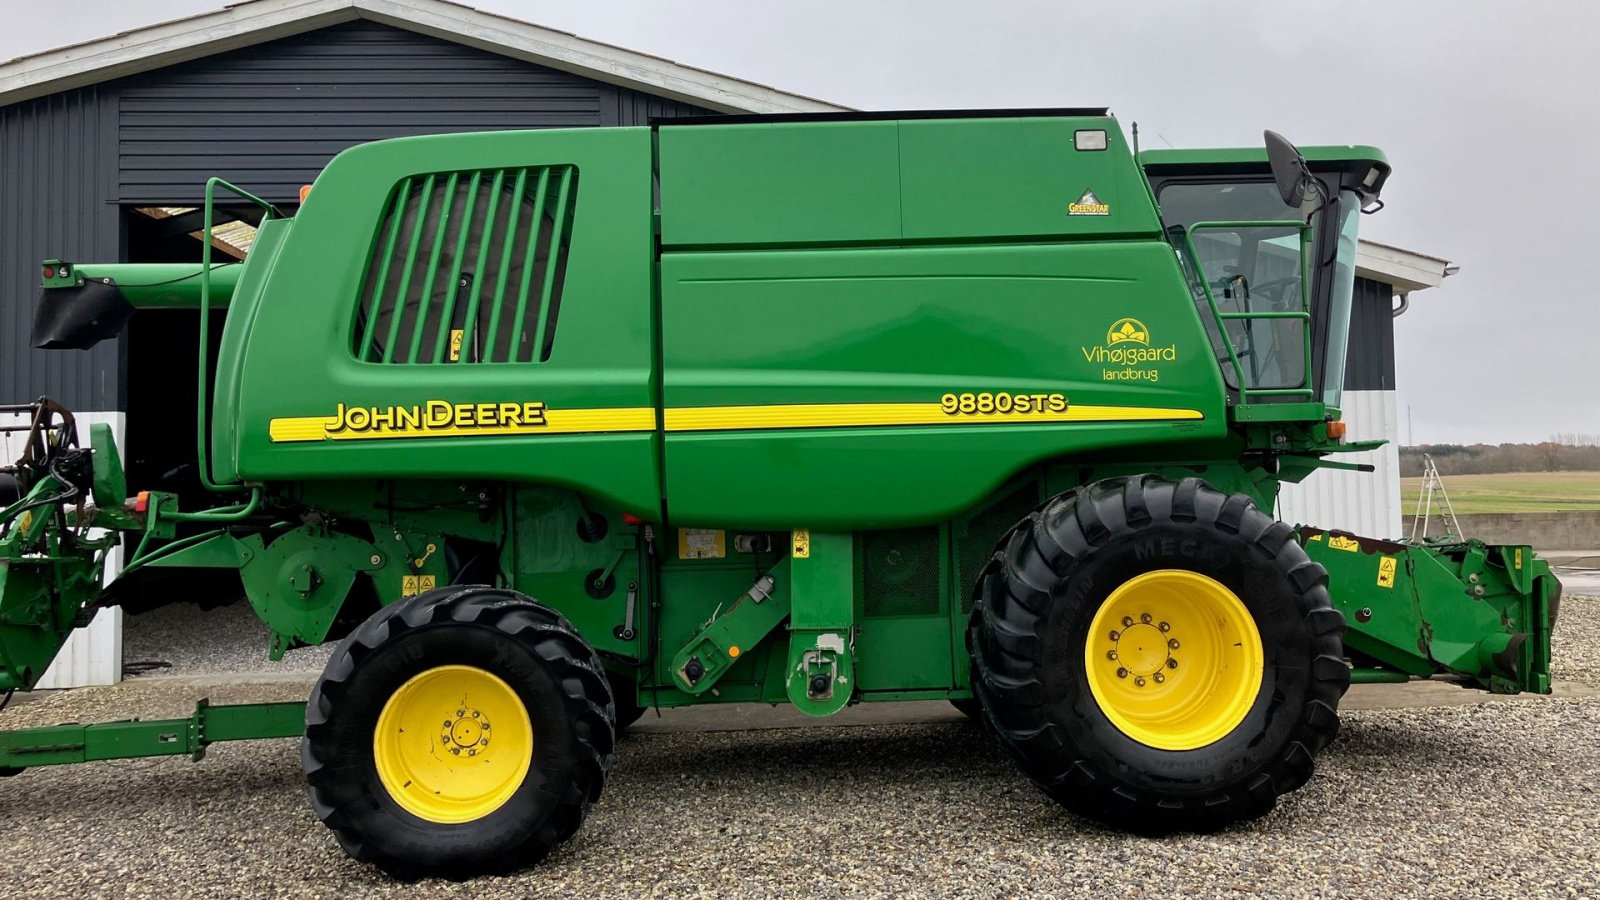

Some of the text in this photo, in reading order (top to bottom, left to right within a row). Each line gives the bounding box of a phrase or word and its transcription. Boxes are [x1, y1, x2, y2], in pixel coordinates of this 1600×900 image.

[1082, 344, 1176, 366] Vihøjgaard
[1102, 368, 1159, 382] landbrug
[940, 391, 1068, 416] 9880STS
[325, 399, 547, 432] JOHN DEERE
